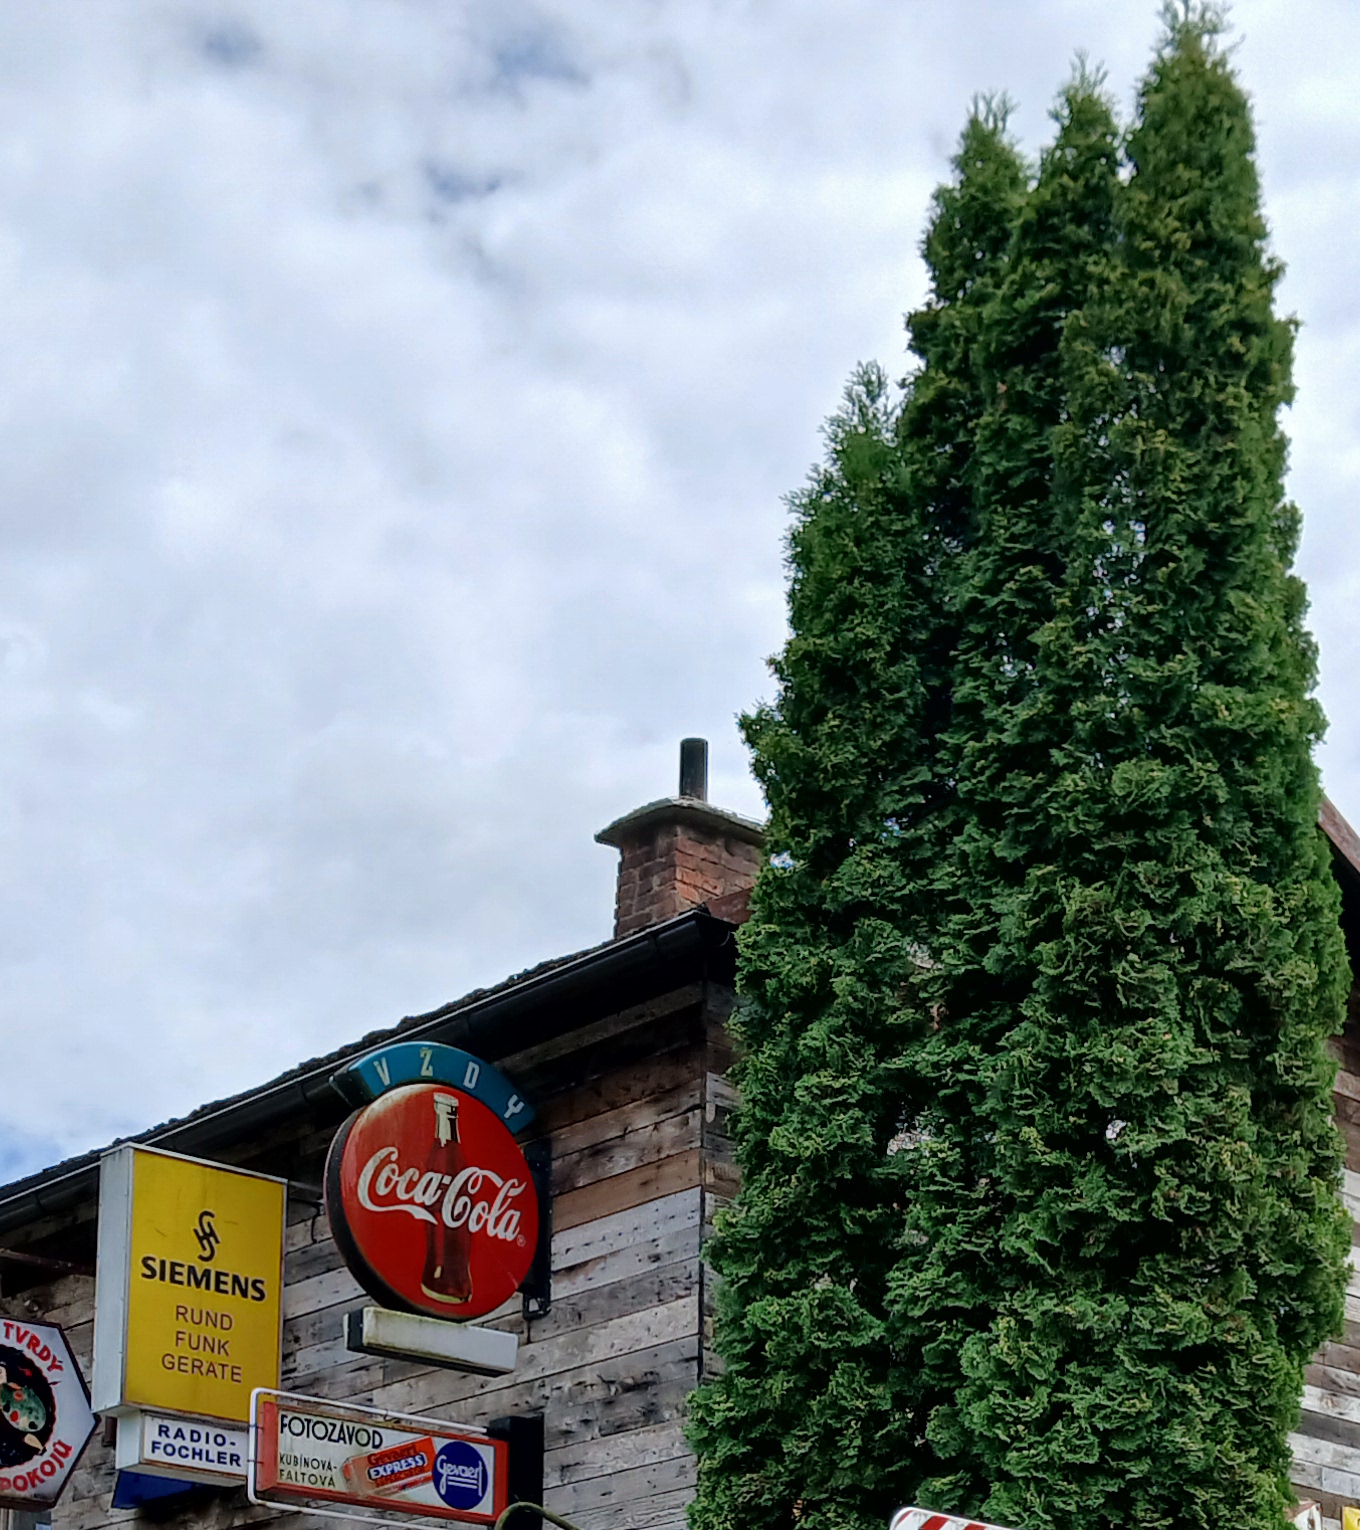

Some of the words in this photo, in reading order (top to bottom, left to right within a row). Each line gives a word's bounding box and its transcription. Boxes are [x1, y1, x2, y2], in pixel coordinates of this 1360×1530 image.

[373, 1047, 525, 1119] VŽDY
[357, 1146, 527, 1243] Coca-Cola
[140, 1256, 267, 1302] SIEMENS
[175, 1304, 234, 1331] RUND
[2, 1321, 65, 1373] TVRDÝ
[175, 1330, 230, 1357] FUNK
[161, 1353, 242, 1384] GERÄTE
[158, 1424, 237, 1447] RADIO-
[151, 1441, 242, 1467] FOCHLER
